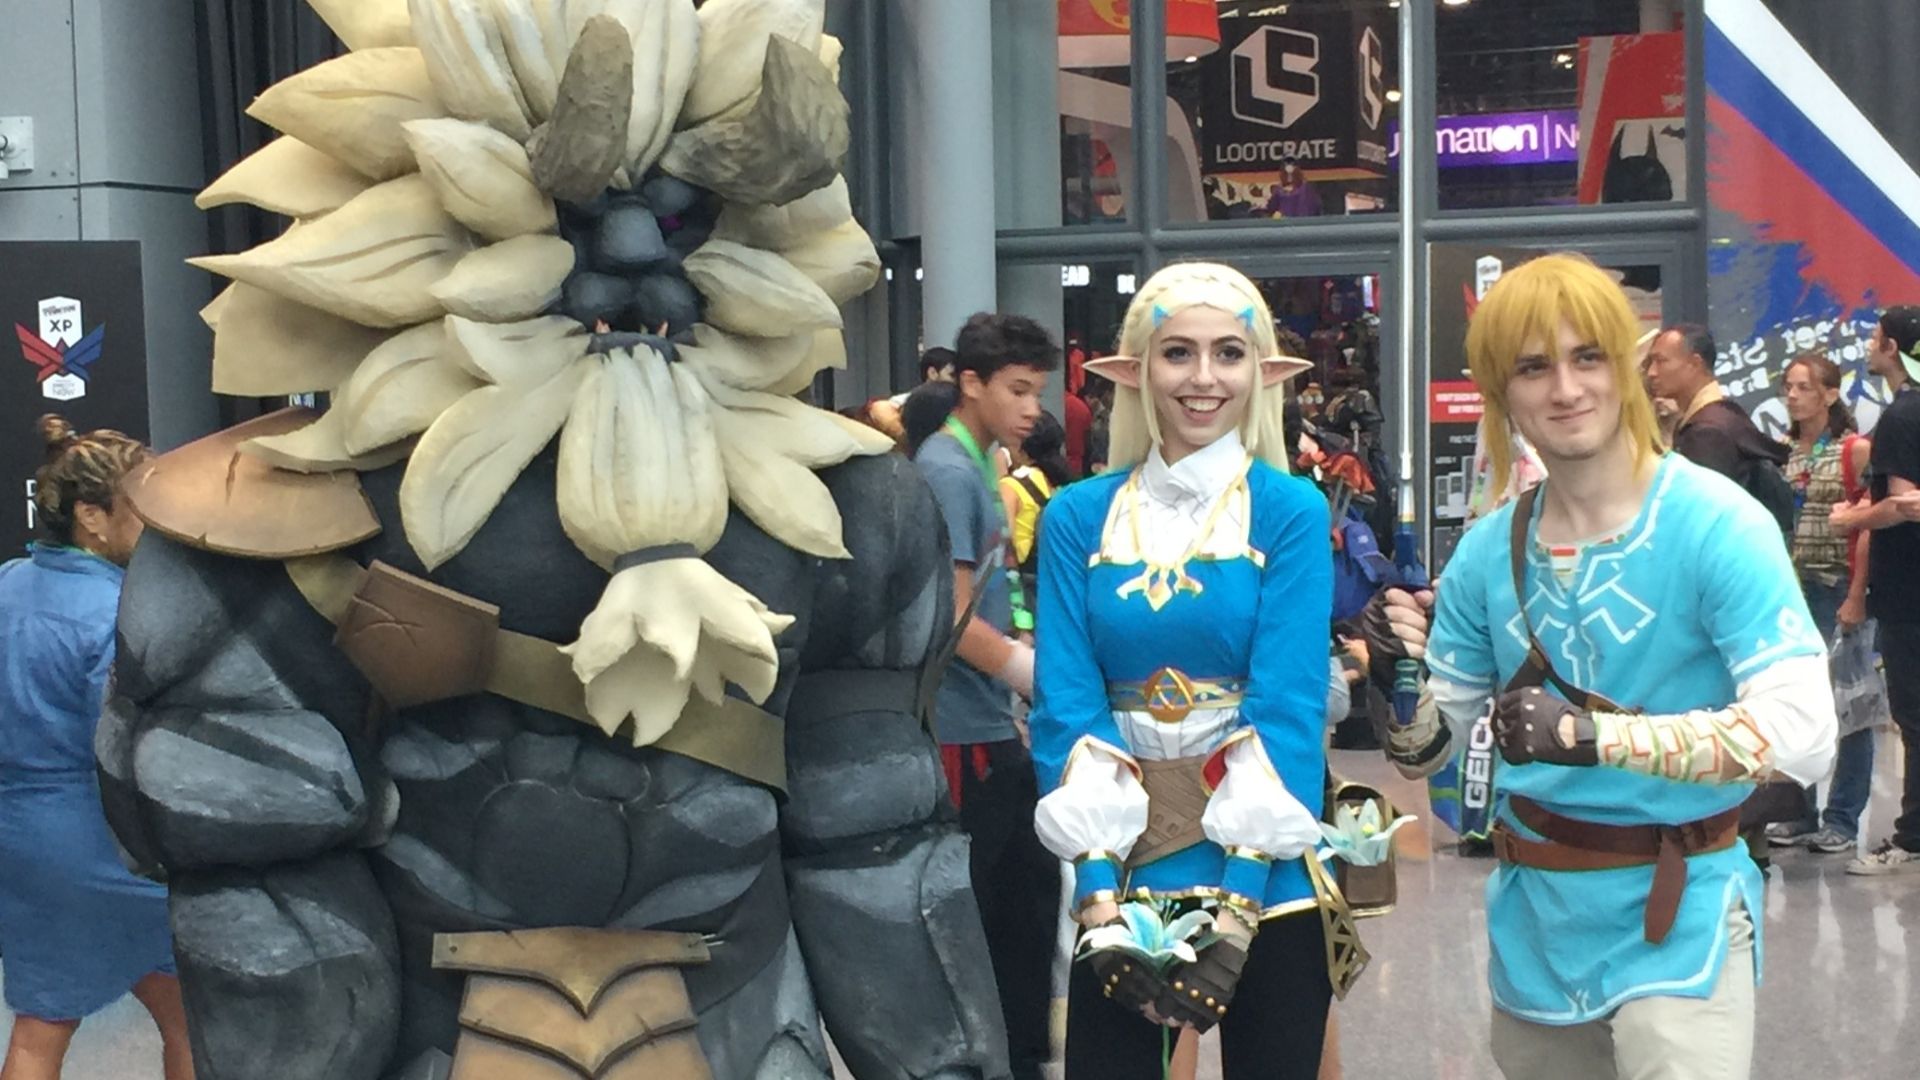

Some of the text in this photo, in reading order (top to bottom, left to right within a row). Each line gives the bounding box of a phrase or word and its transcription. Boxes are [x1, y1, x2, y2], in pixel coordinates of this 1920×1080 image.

[1216, 139, 1337, 163] LOOTCRATE
[1061, 264, 1090, 287] EAD
[49, 319, 73, 333] XP
